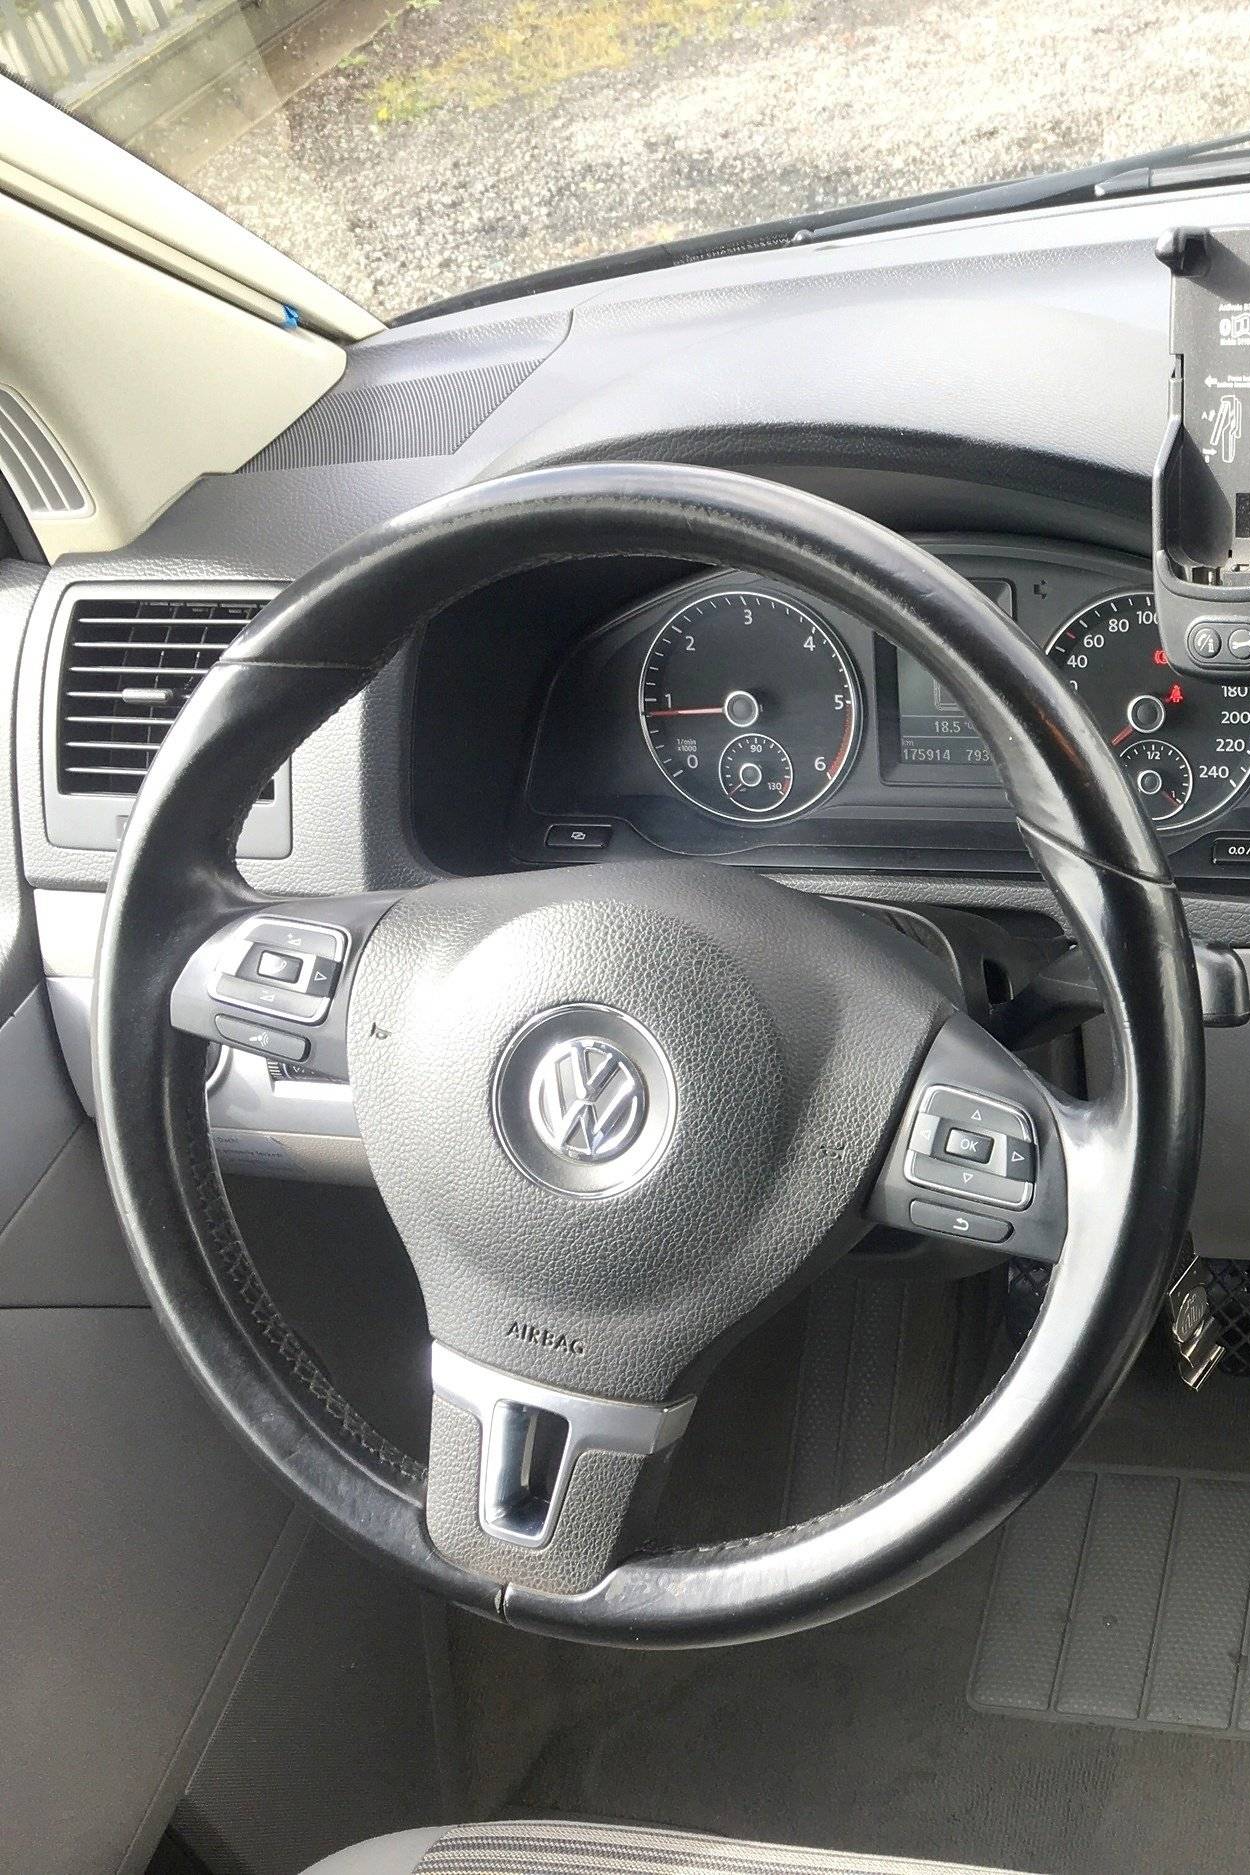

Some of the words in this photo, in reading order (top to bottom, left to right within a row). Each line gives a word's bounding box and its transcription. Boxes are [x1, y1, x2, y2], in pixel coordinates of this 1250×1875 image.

[744, 609, 753, 625] 3
[1108, 618, 1130, 633] 80
[685, 635, 696, 651] 2
[803, 636, 816, 652] 4
[1084, 634, 1104, 648] 60
[1066, 654, 1088, 668] 40
[1222, 685, 1248, 698] 180
[664, 694, 672, 709] 1
[834, 694, 844, 710] 5
[1221, 711, 1250, 724] 200
[934, 720, 961, 733] 18.5
[750, 744, 762, 753] 90
[1216, 738, 1245, 752] 220
[686, 754, 699, 769] 0
[903, 748, 951, 761] 175914
[814, 756, 826, 772] 6
[1199, 766, 1229, 779] 240
[767, 782, 782, 791] 130
[960, 1138, 979, 1152] OK
[506, 1320, 585, 1355] AIRBAG
